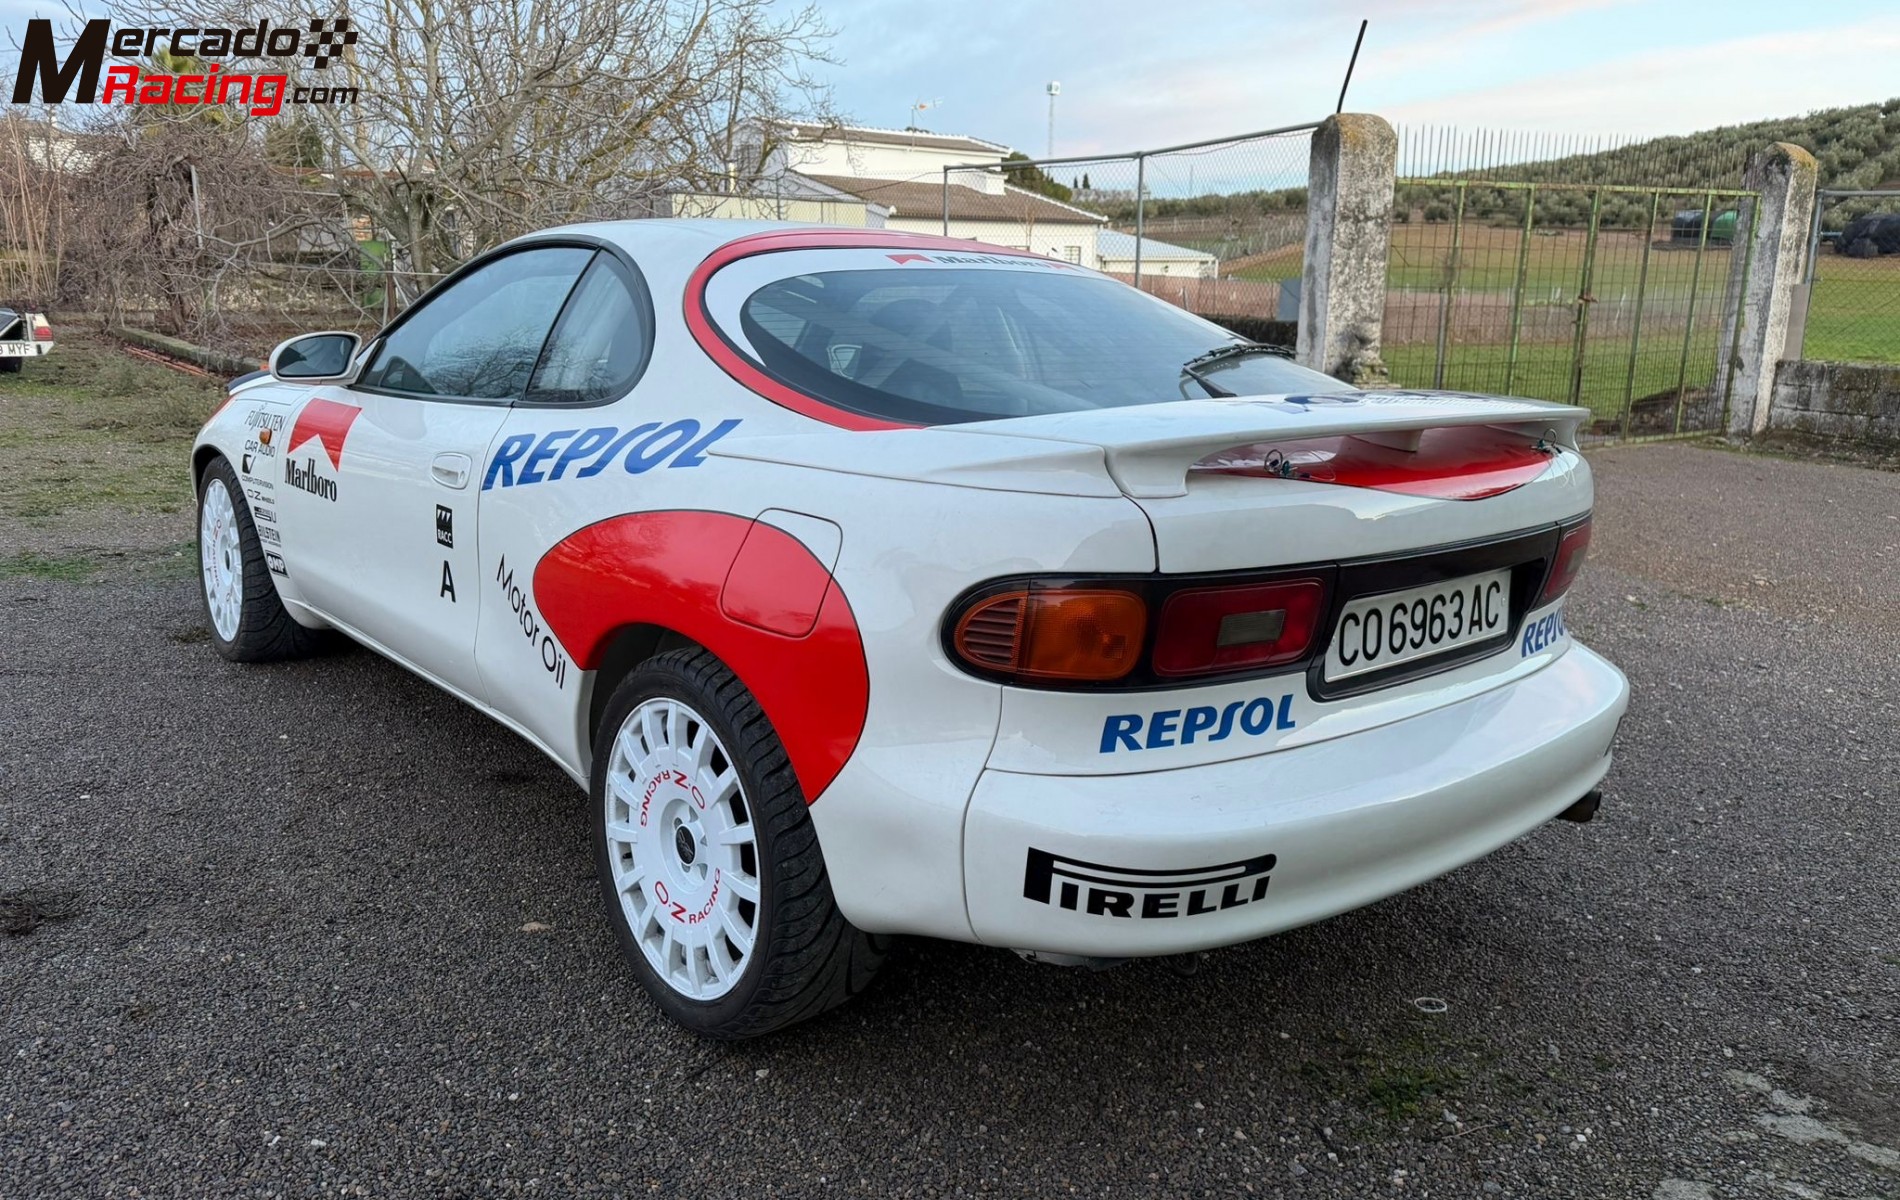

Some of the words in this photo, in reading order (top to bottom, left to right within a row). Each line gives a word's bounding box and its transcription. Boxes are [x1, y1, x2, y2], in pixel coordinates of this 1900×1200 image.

[245, 440, 259, 453] CAR
[481, 418, 744, 491] REPSOL
[284, 457, 338, 502] Marlboro
[267, 555, 285, 573] OMP
[437, 528, 452, 545] RACC
[439, 559, 457, 603] A
[496, 553, 540, 647] Motor
[541, 635, 567, 689] Oil
[1099, 693, 1297, 755] REPSOL
[640, 769, 671, 827] RACING
[688, 867, 721, 925] RACING
[1023, 846, 1278, 919] PIRELLI
